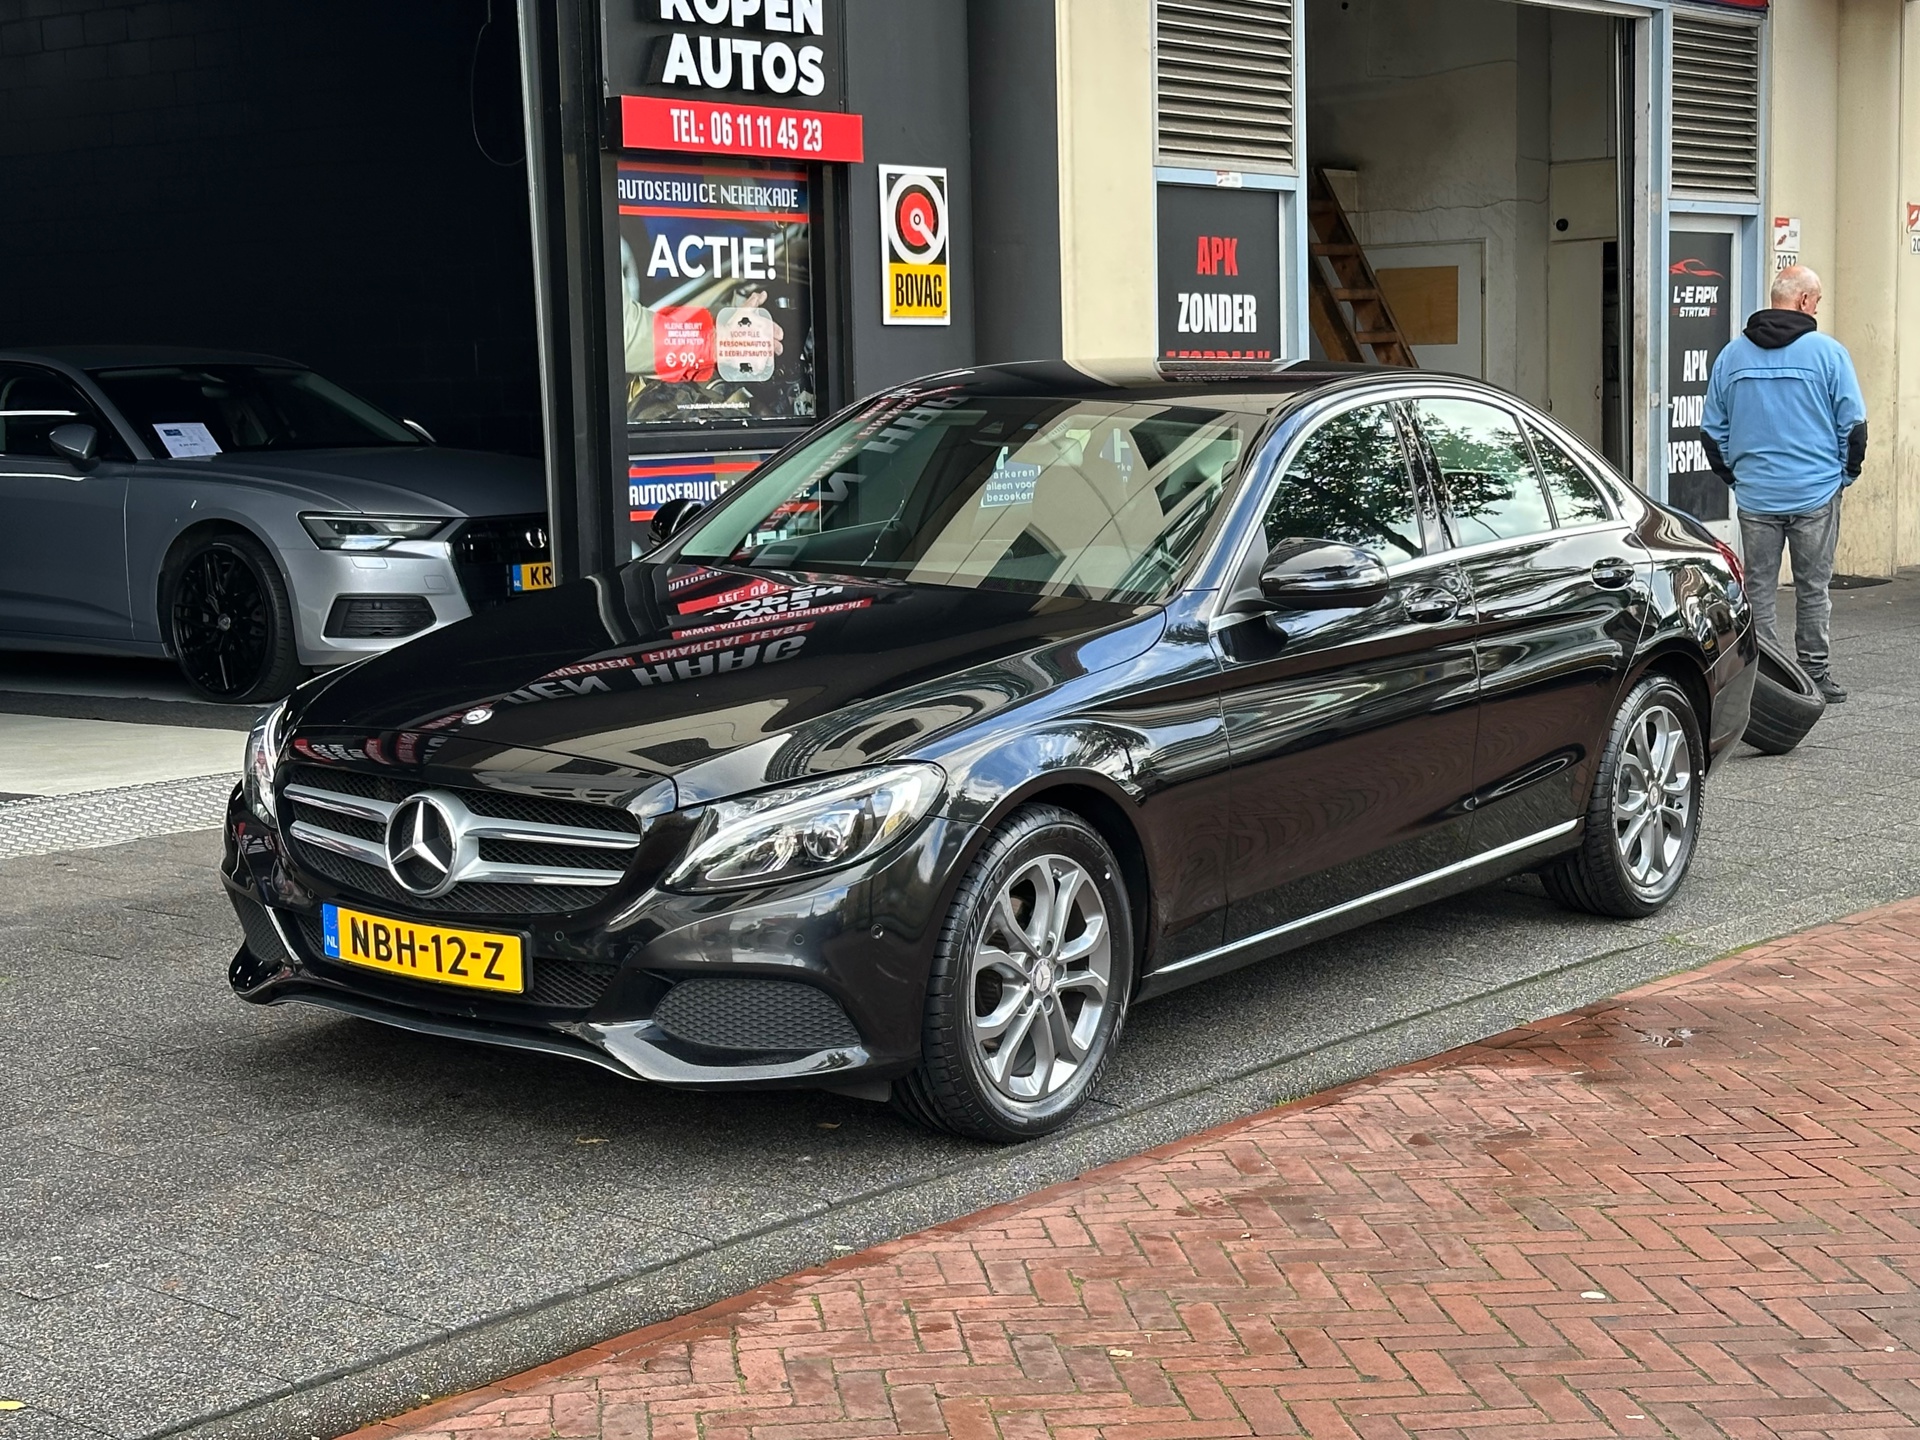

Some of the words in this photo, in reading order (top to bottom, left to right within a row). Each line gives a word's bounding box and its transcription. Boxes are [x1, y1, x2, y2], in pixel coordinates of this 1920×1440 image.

[662, 33, 825, 96] AUTOS
[670, 108, 705, 144] TEL:
[710, 111, 732, 146] 06
[737, 114, 752, 147] 11
[757, 115, 772, 148] 11
[777, 117, 798, 150] 45
[803, 118, 822, 152] 23
[618, 179, 717, 203] AUTOSERVICE
[720, 184, 799, 208] NEHERKADE
[646, 234, 777, 280] ACTIE!
[1196, 236, 1239, 276] APK
[895, 273, 943, 308] BOVAG
[1695, 286, 1719, 304] APK
[1177, 293, 1257, 333] ZONDER
[1679, 306, 1711, 318] STATION
[665, 352, 677, 368] €
[679, 352, 704, 369] 99,-
[1683, 350, 1708, 382] APK
[1672, 395, 1706, 428] ZOND
[986, 482, 1013, 491] alleen
[1015, 481, 1036, 489] voor
[993, 469, 1035, 479] arkeren
[530, 566, 552, 586] KR
[326, 934, 338, 949] NL
[350, 916, 505, 981] NBH-12-Z
